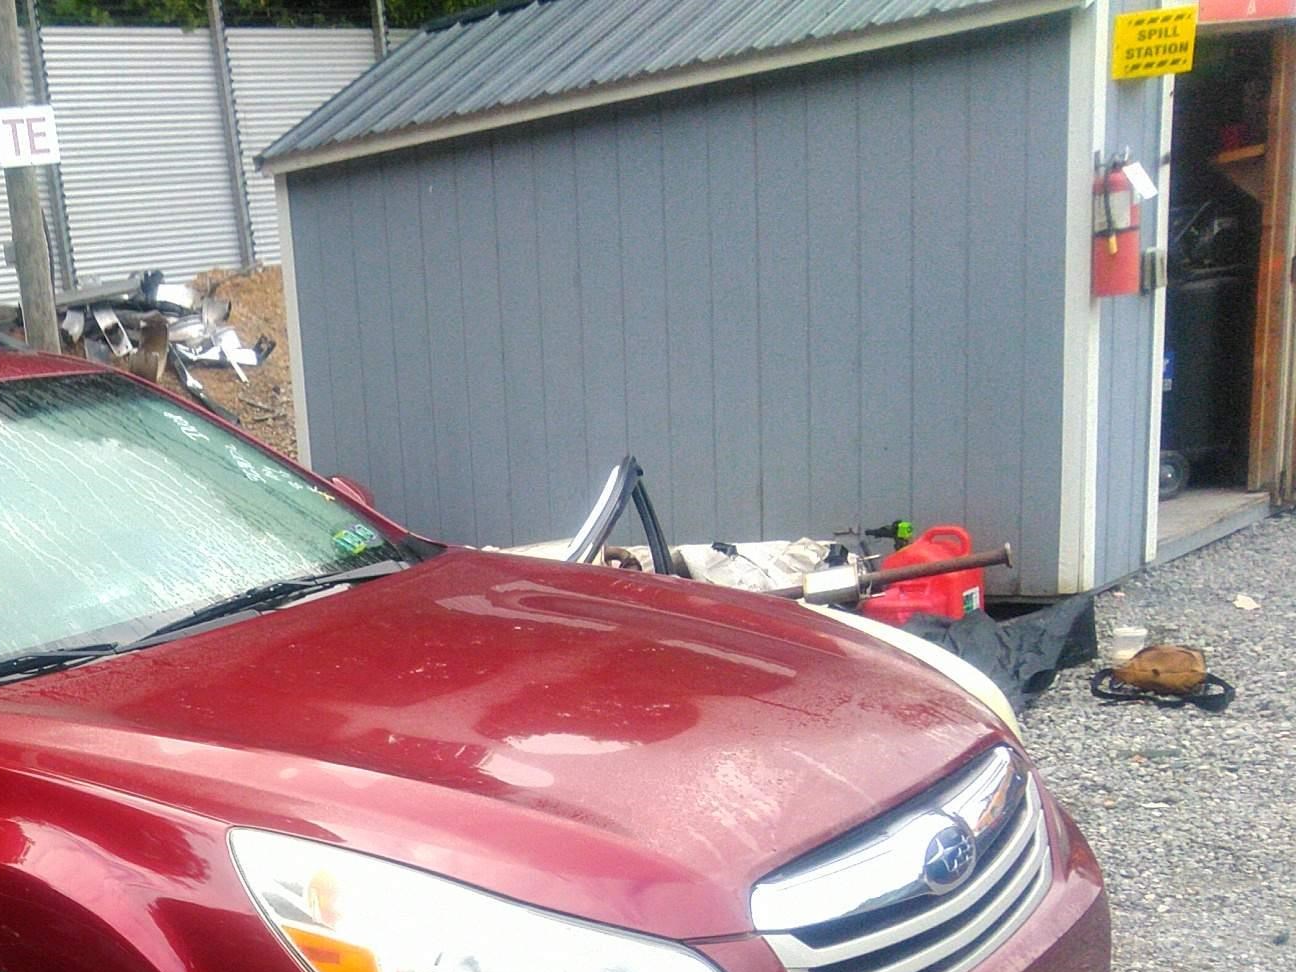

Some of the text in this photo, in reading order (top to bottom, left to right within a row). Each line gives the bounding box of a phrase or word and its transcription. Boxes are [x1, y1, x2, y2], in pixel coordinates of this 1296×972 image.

[1137, 26, 1180, 42] SPILL
[1125, 42, 1189, 60] STATION
[2, 117, 50, 156] TE
